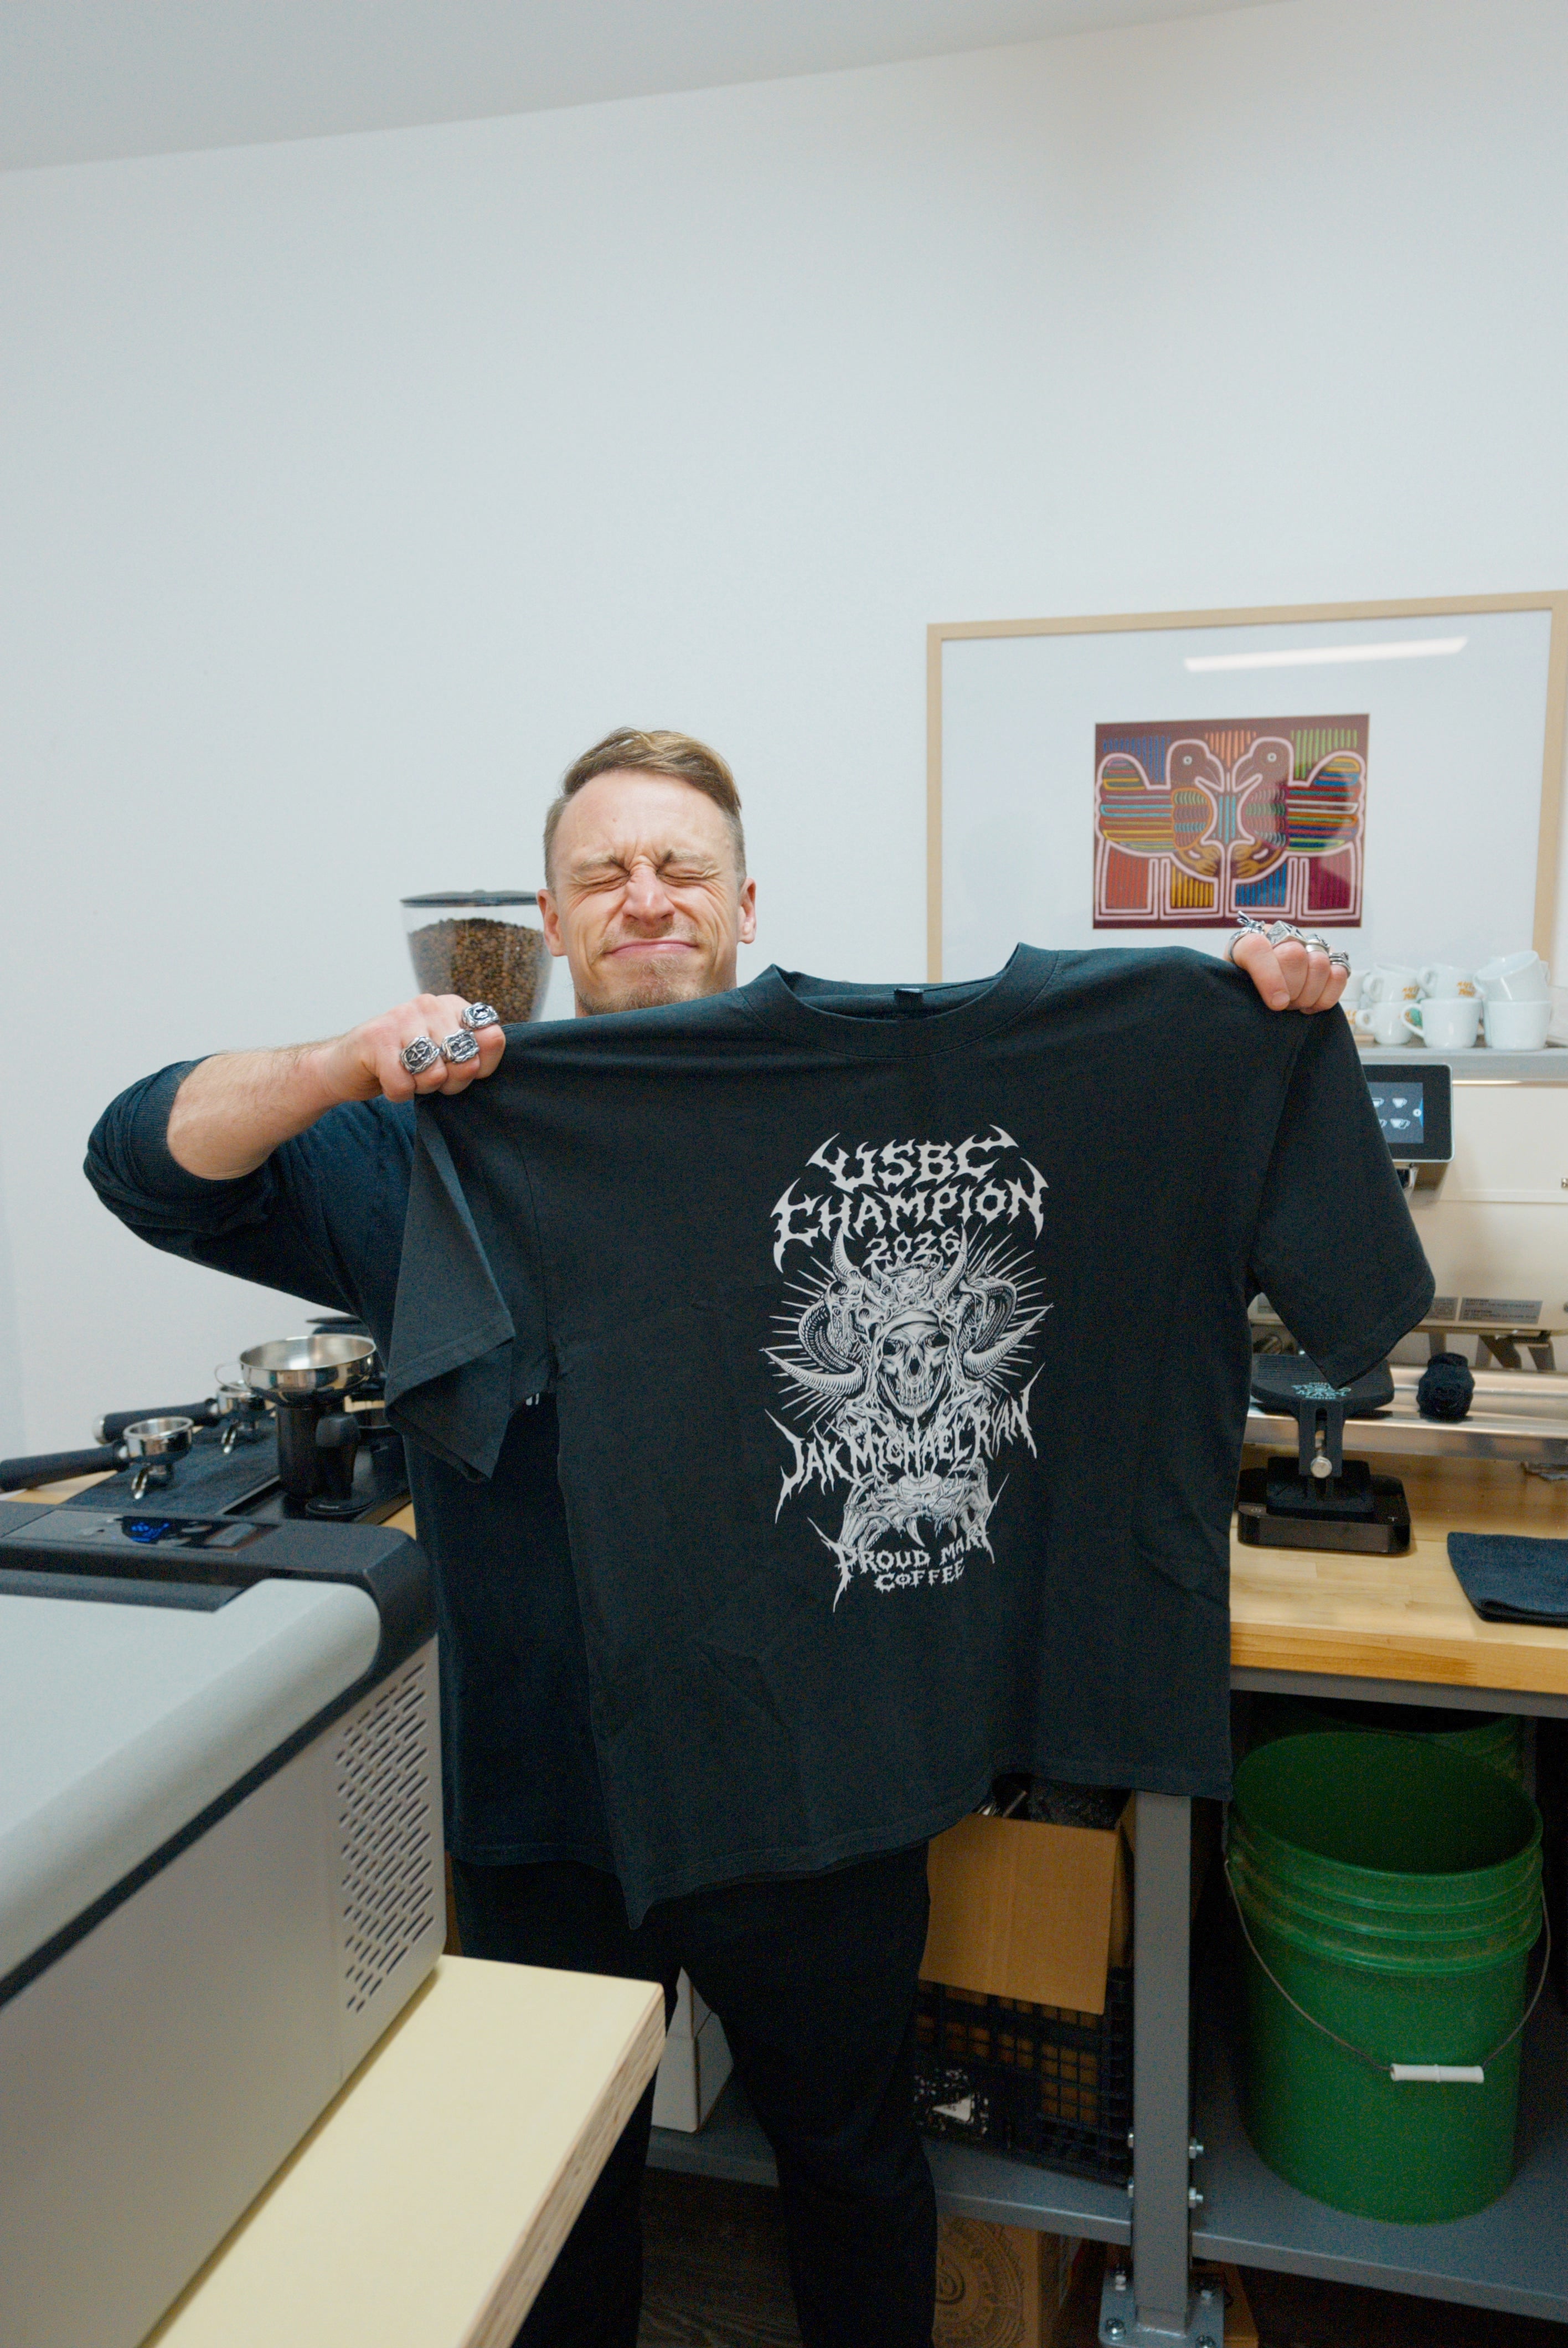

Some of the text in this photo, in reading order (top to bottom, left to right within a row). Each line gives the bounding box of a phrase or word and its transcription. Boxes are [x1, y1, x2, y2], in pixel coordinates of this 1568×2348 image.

[804, 1124, 1019, 1194] USBC
[770, 1157, 1049, 1273] CHAMPION
[861, 1225, 962, 1269] 2026
[764, 1361, 1046, 1525] JAK MICHAEL RYAN
[806, 1516, 931, 1613] PROUD
[874, 1557, 965, 1594] COFFEE
